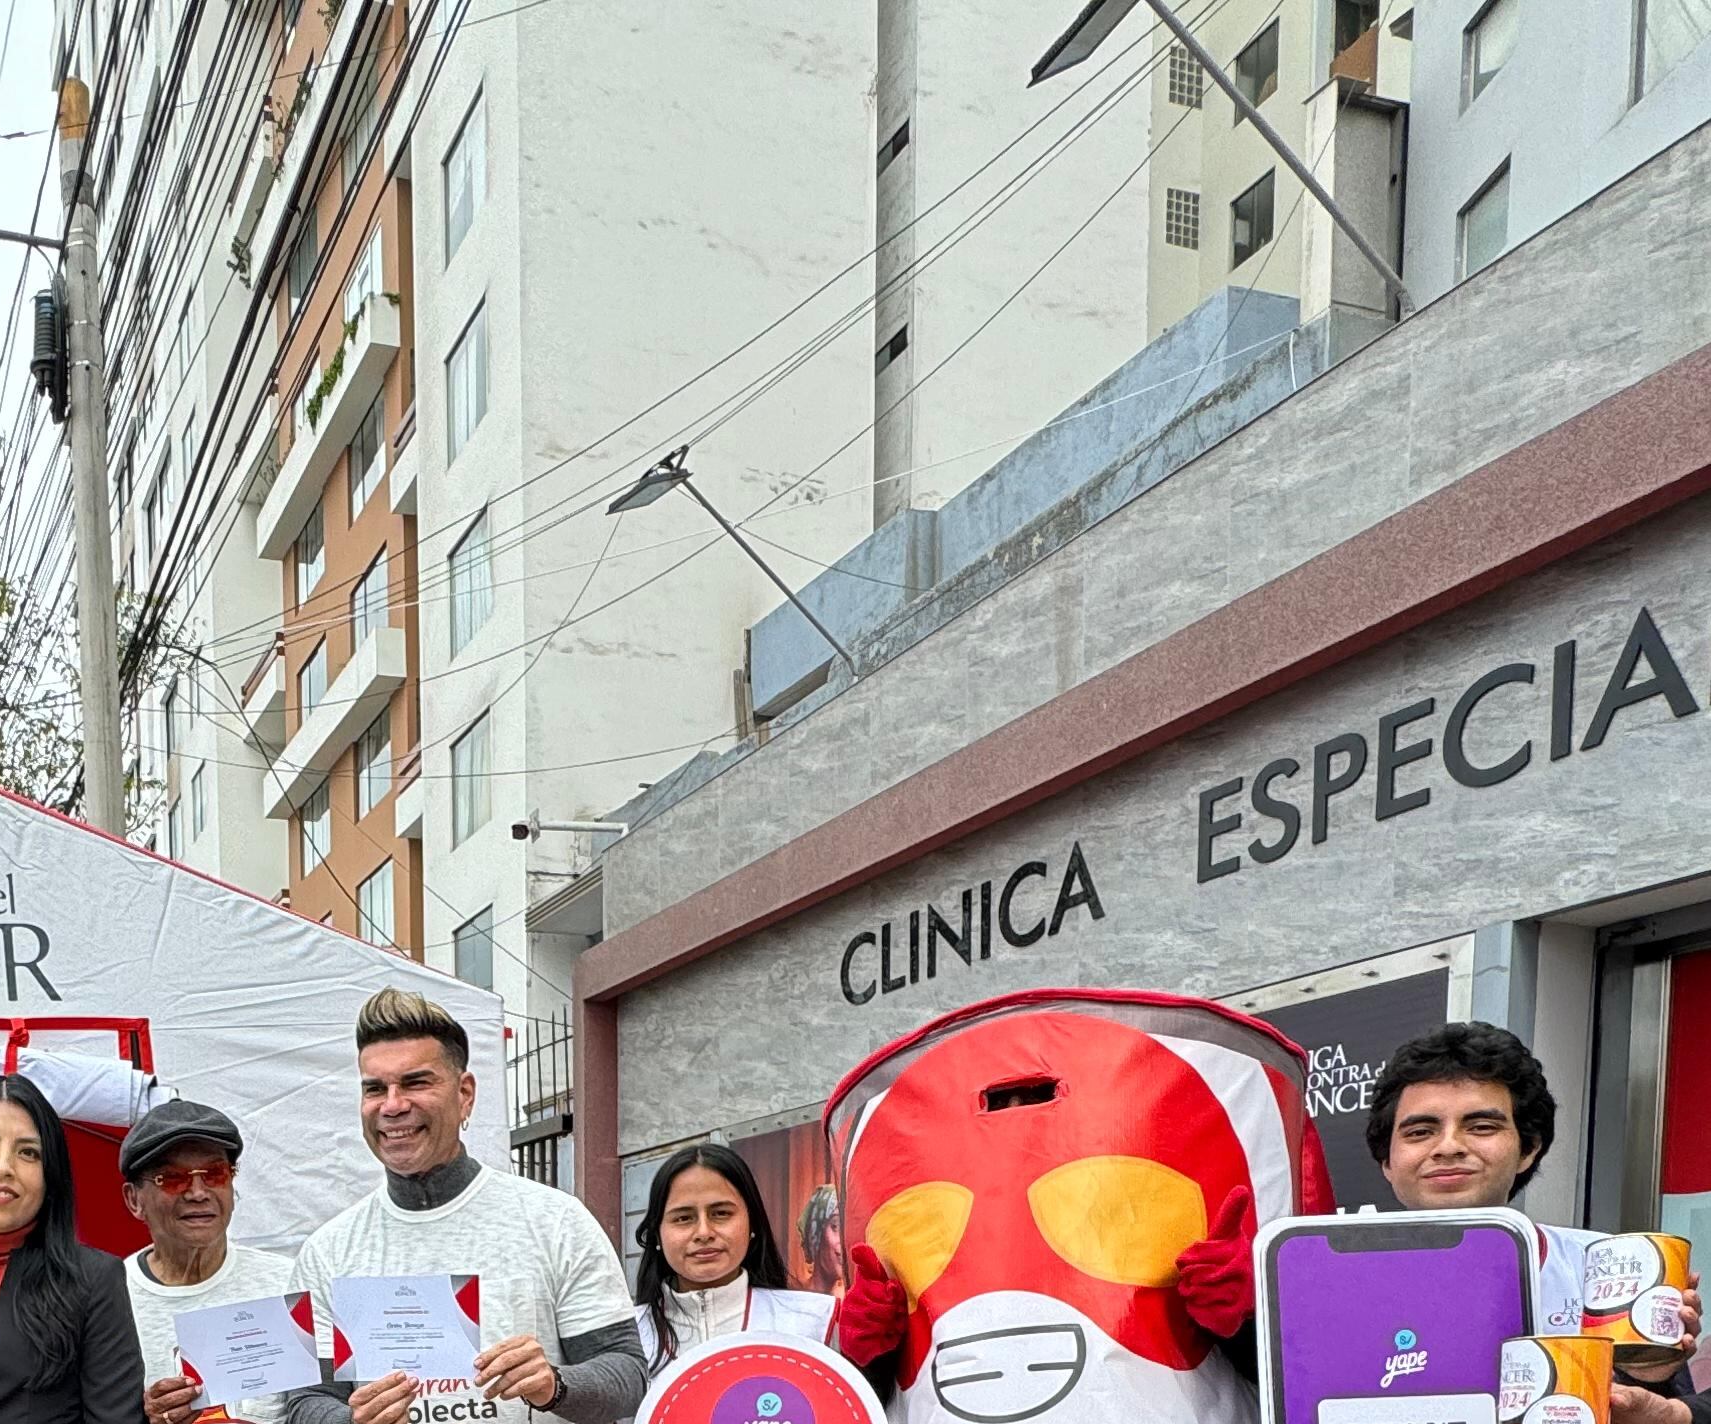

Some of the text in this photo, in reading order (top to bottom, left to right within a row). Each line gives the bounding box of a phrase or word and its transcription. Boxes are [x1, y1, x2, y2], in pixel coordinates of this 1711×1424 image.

[1197, 606, 1711, 884] ESPECIA
[840, 840, 1105, 1006] CLINICA
[1307, 1043, 1347, 1074] IGA
[1307, 1062, 1372, 1090] ONTRA
[1592, 1281, 1639, 1301] 2024
[1380, 1350, 1428, 1388] yape
[408, 1398, 498, 1424] olecta
